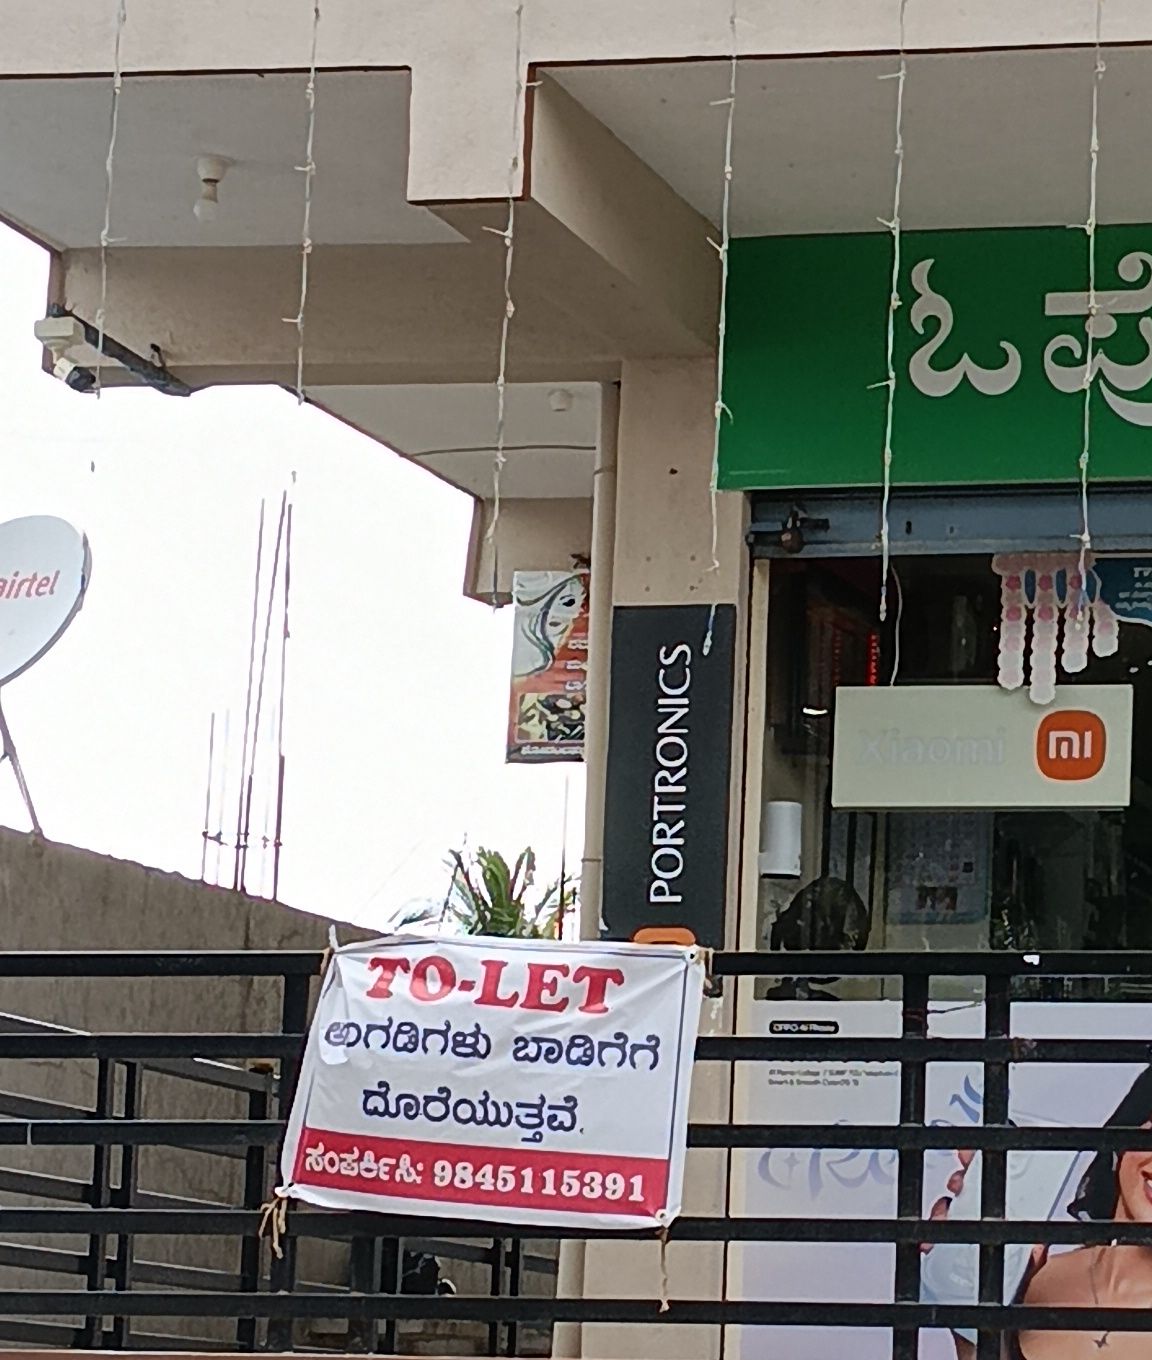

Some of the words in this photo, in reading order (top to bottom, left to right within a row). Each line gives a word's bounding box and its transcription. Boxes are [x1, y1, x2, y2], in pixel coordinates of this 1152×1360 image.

[649, 643, 692, 904] PORTRONICS
[364, 955, 626, 1015] TO-LET
[512, 1031, 661, 1071] ಬಾಡಿಗೆಗೆ
[433, 1159, 646, 1202] 9845115391
